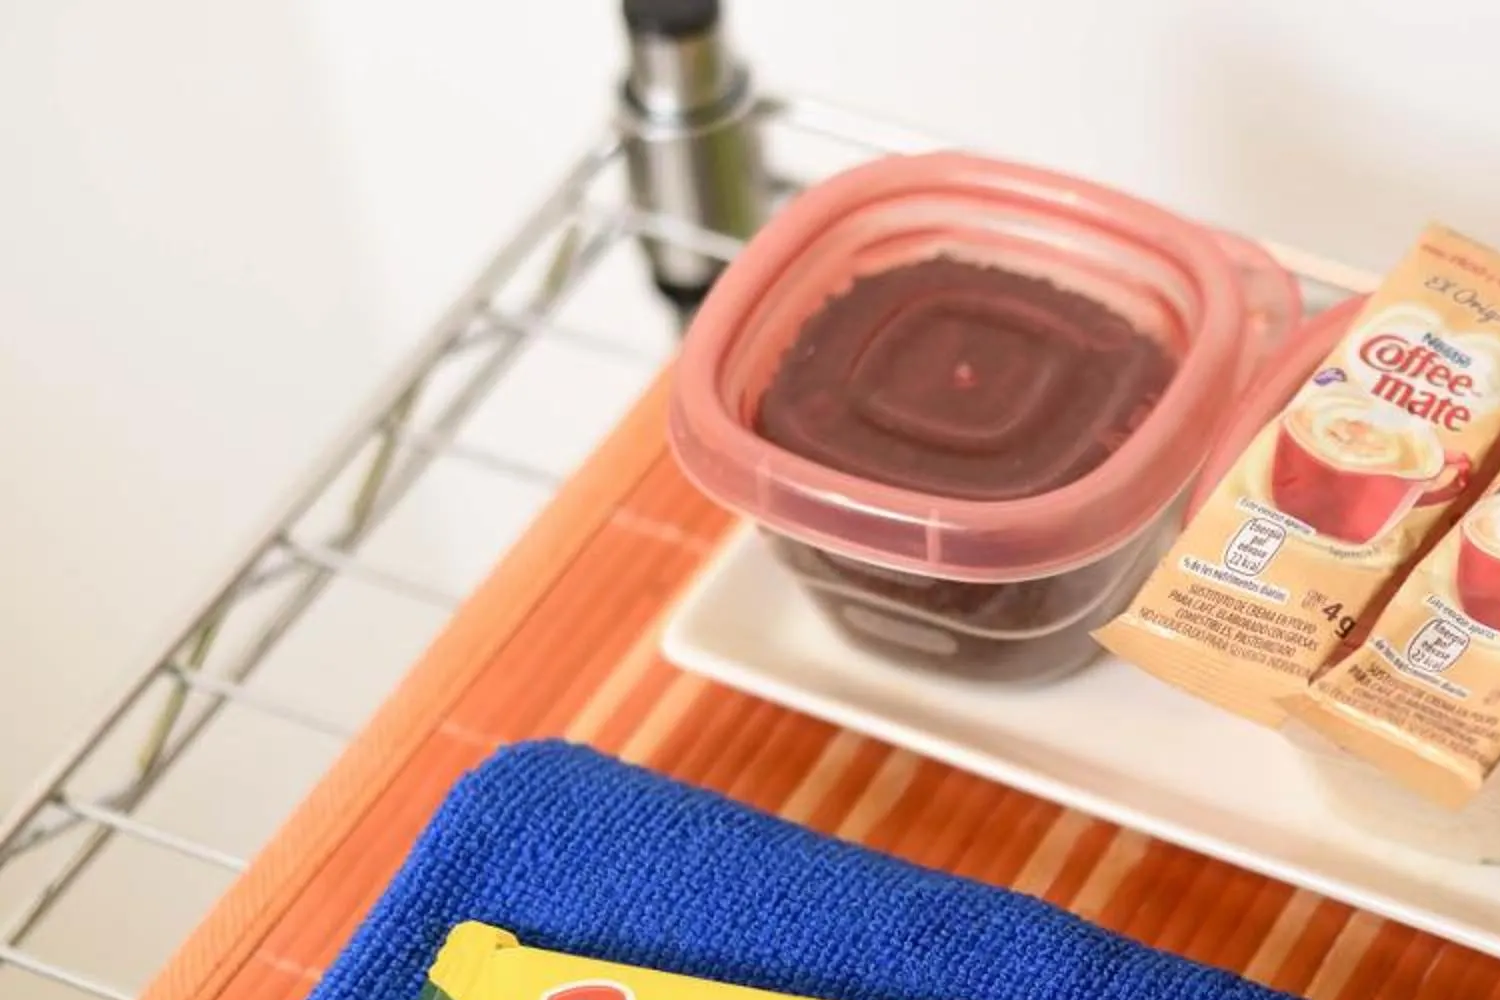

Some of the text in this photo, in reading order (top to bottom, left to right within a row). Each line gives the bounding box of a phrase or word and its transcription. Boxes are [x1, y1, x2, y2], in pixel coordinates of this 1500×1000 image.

[1371, 373, 1472, 432] mate
[1322, 602, 1357, 640] 4 g
